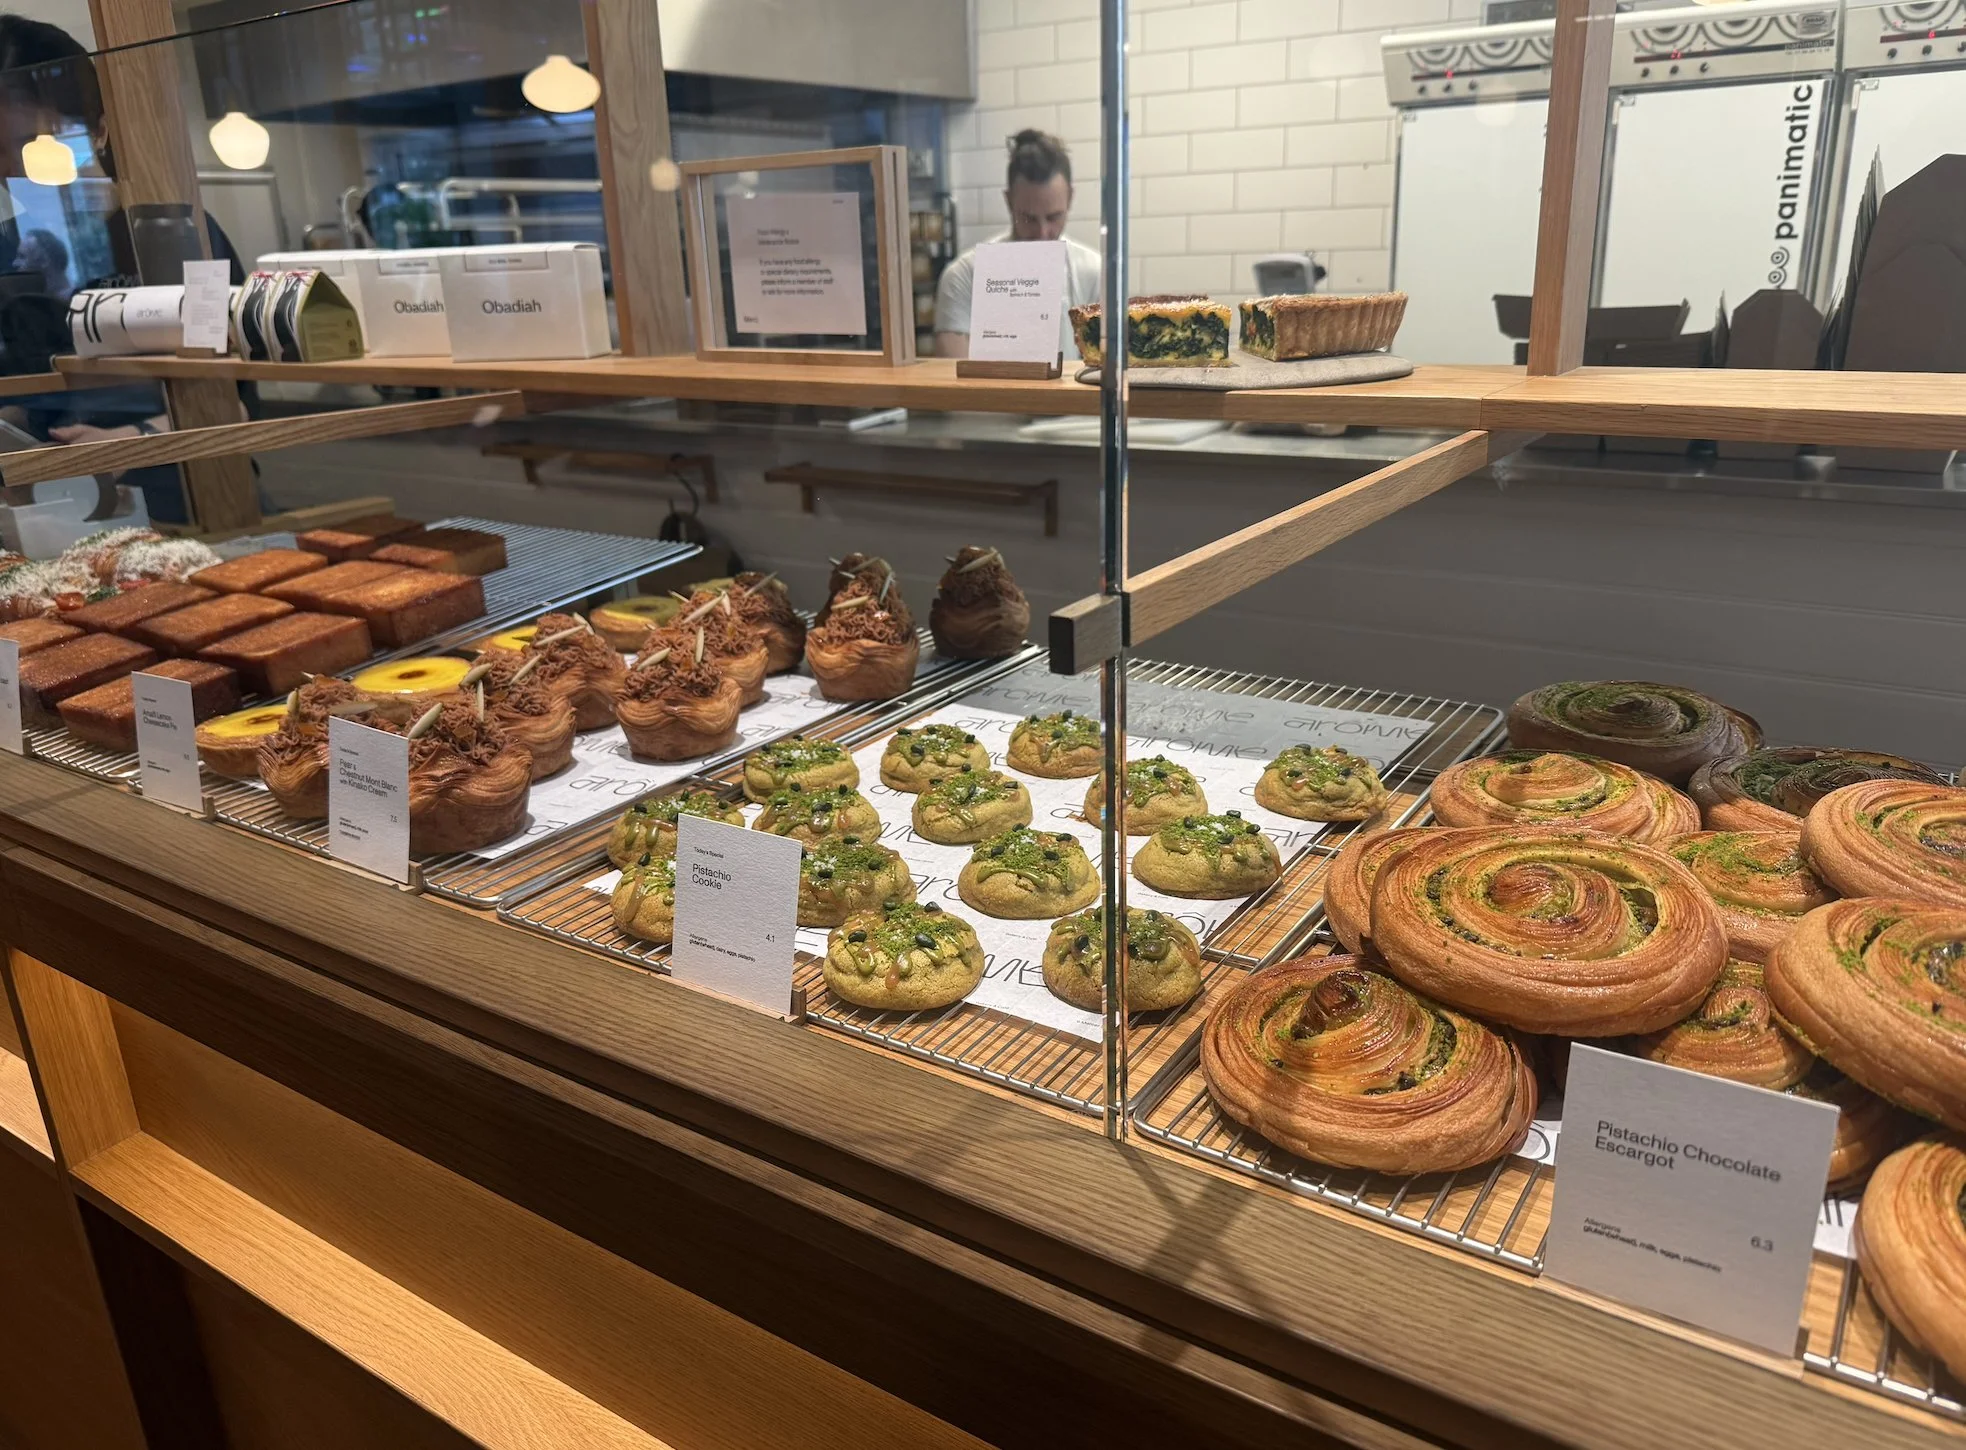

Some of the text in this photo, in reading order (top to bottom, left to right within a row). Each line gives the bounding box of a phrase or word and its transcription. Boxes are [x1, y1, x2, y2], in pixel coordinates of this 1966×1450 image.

[1775, 84, 1813, 239] panimatic
[986, 278, 1039, 287] Seasonal Veggie
[394, 300, 444, 314] Obadiah
[482, 300, 542, 314] Obadiah
[339, 758, 353, 769] Pear
[339, 767, 398, 793] Chestnut Mont Blanc
[347, 779, 368, 793] Kinako
[368, 785, 388, 798] Cream
[692, 863, 732, 882] Pistachio
[692, 874, 722, 890] Cookie
[765, 933, 775, 943] 4.1
[1595, 1135, 1676, 1170] Escargot
[1596, 1120, 1782, 1183] Pistachio Chocolate
[1584, 1217, 1621, 1233] Allergens
[1750, 1235, 1774, 1252] 6.3
